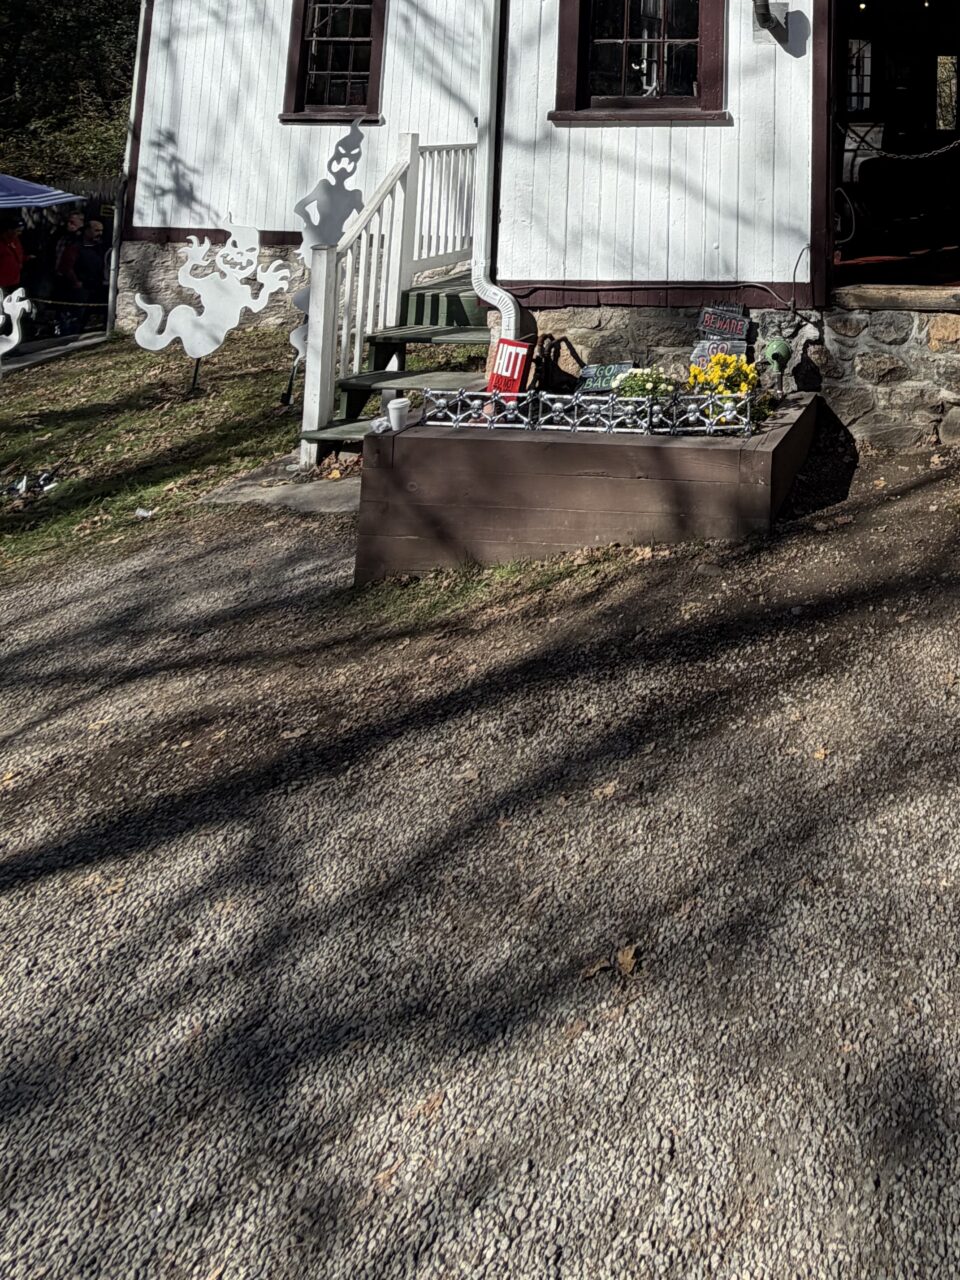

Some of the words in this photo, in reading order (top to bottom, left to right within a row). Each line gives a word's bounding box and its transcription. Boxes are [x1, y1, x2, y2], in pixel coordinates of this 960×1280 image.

[703, 312, 745, 335] BEWARE
[708, 342, 729, 356] GO
[493, 343, 528, 380] HOT
[596, 365, 615, 377] GO
